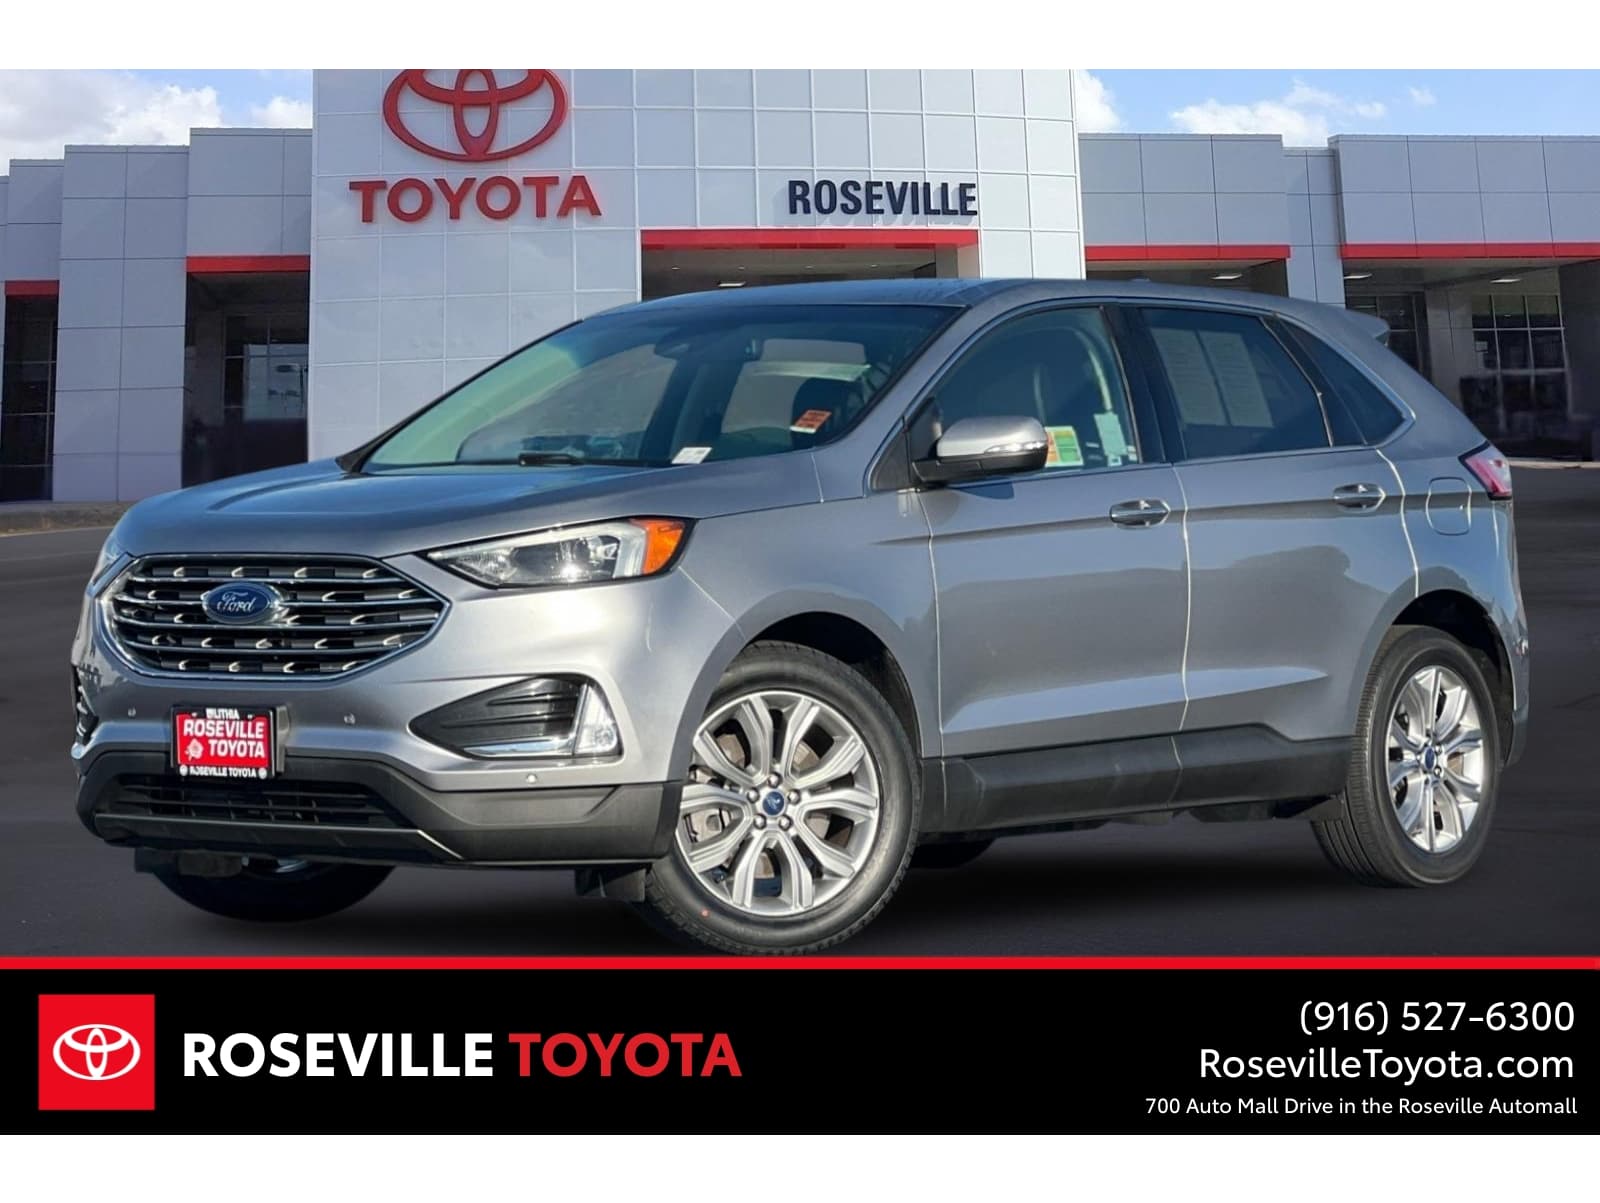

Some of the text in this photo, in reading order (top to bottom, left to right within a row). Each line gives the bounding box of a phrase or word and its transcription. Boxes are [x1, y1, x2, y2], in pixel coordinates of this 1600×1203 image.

[349, 175, 602, 223] TOYOTA
[788, 179, 978, 216] ROSEVILLE
[216, 590, 257, 613] Ford
[183, 718, 265, 739] ROSEVILLE
[207, 739, 265, 758] TOYOTA
[189, 766, 257, 778] ROSEVILLE TOYOTA
